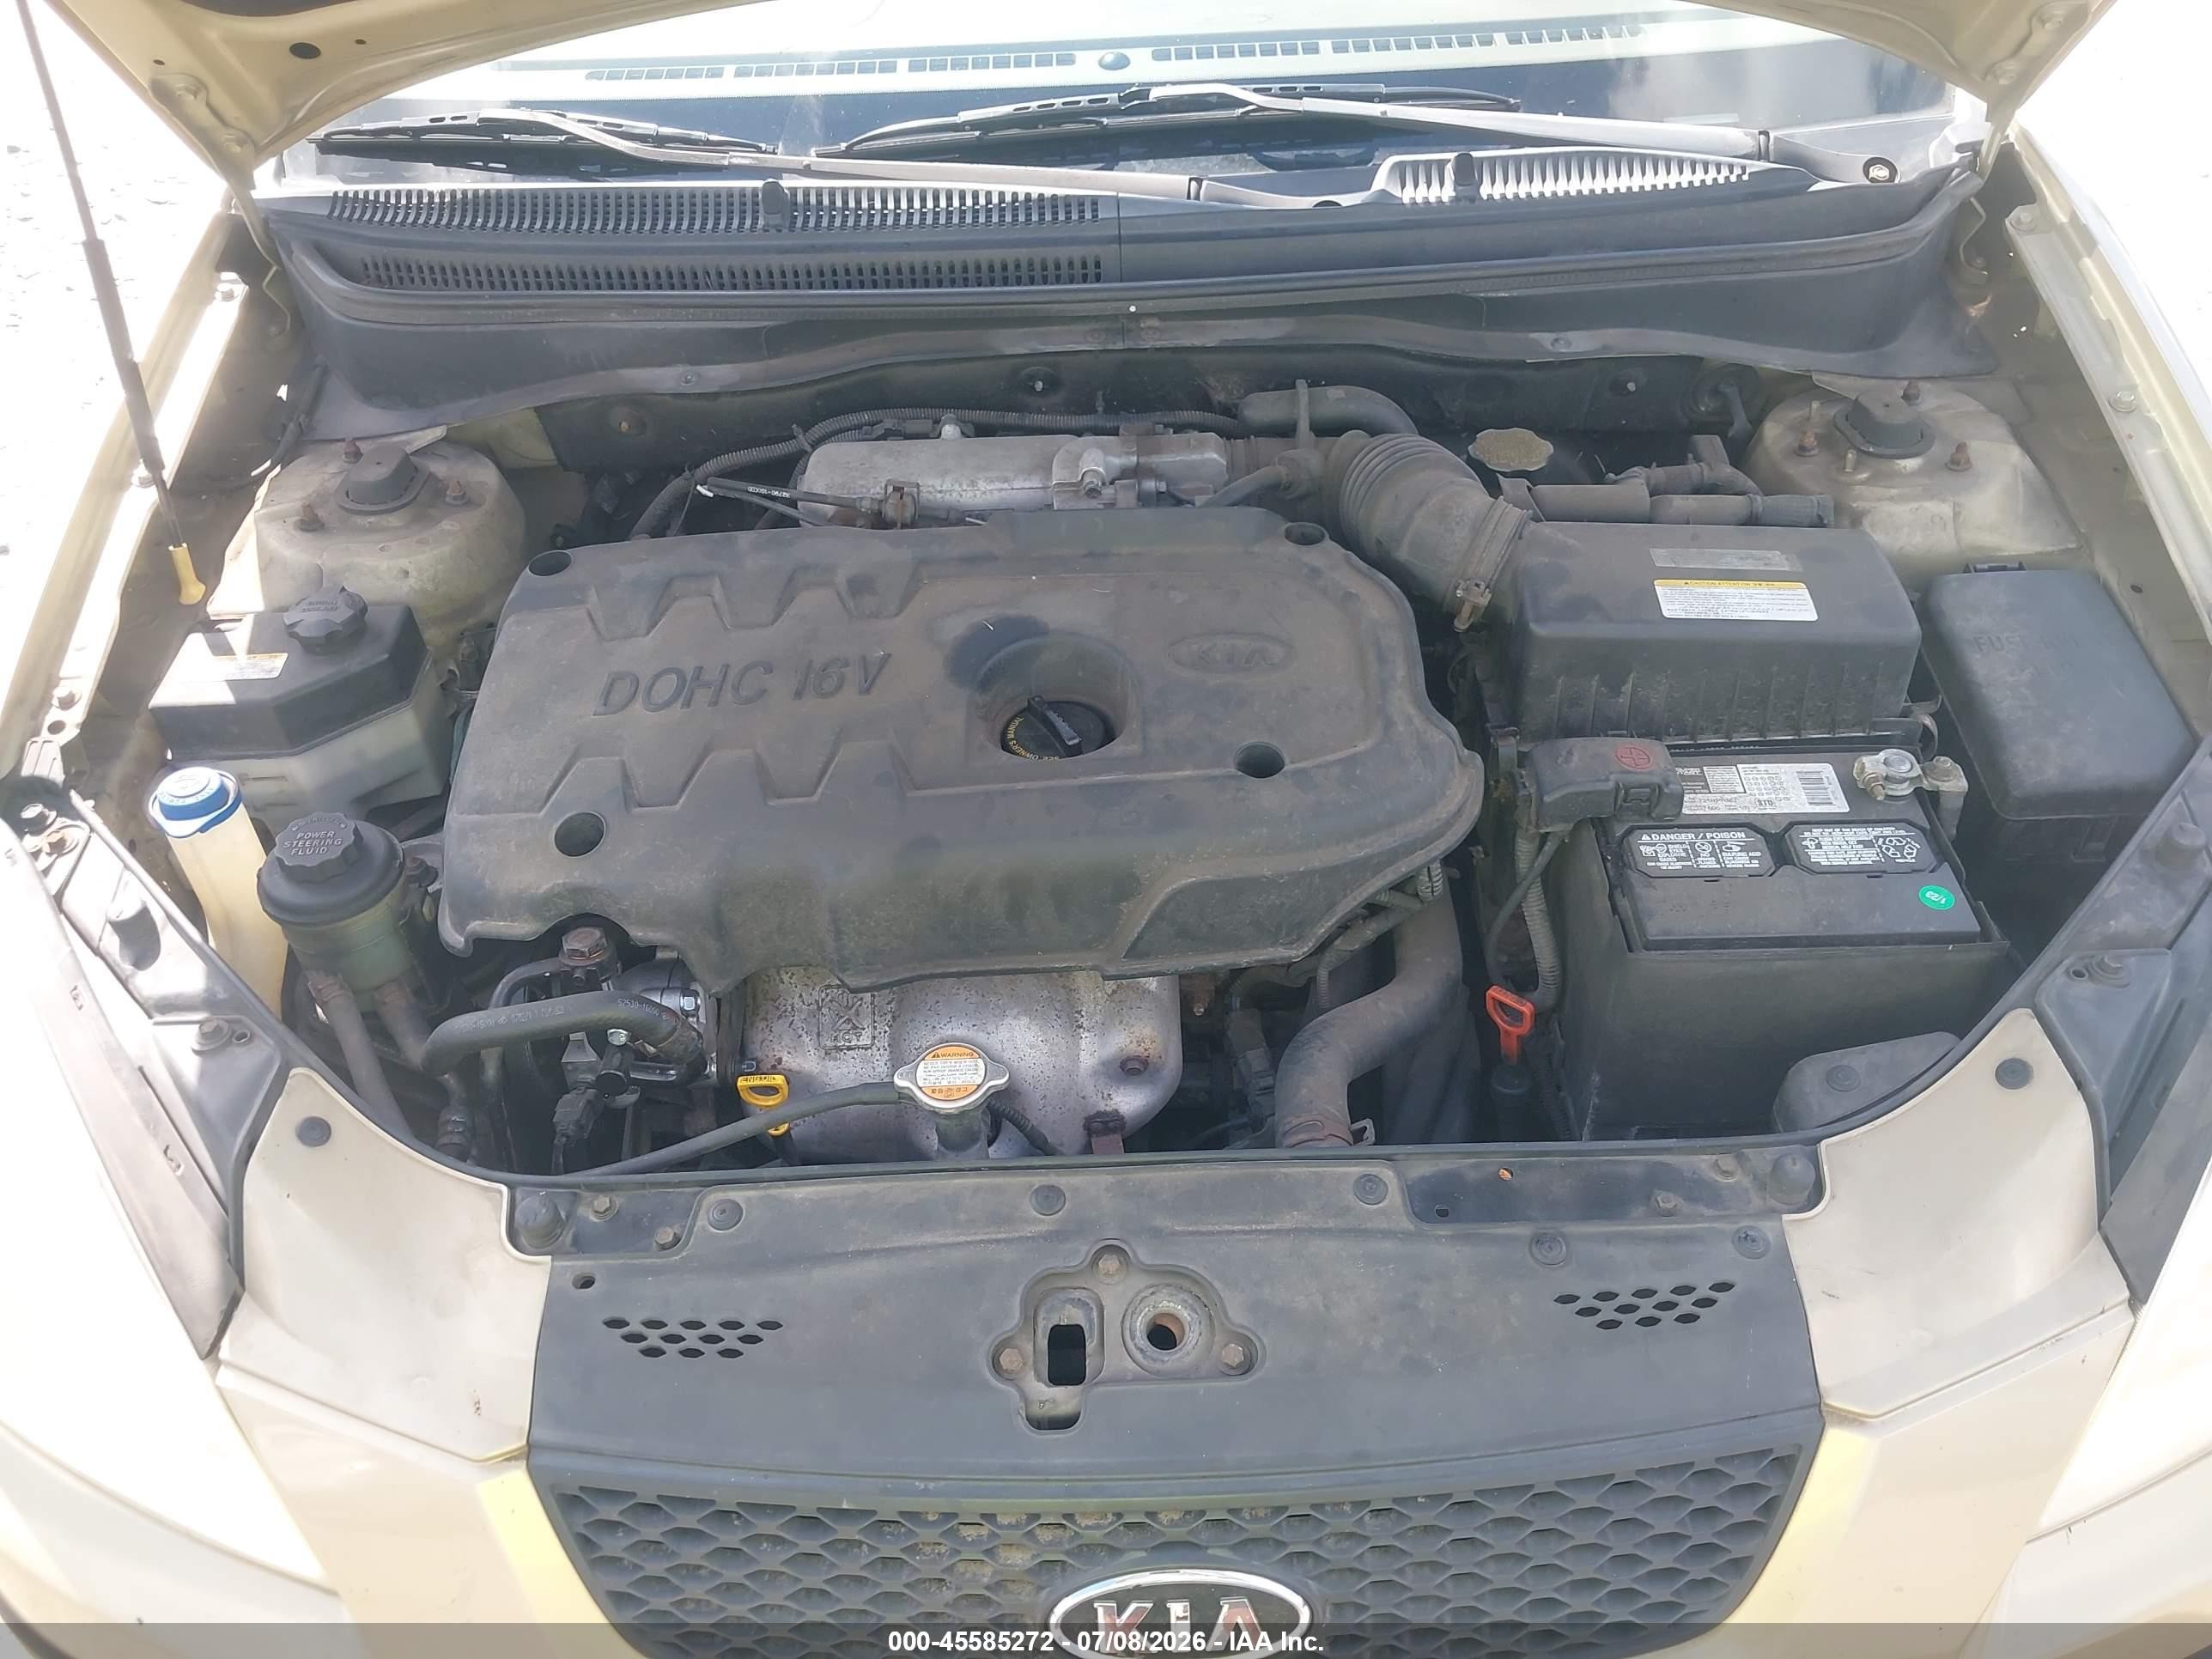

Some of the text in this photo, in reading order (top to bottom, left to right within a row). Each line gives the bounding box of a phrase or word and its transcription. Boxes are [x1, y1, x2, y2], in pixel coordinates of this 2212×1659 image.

[592, 652, 893, 717] DOHC 16V
[296, 830, 336, 840] POWER
[1705, 831, 1746, 840] POISON
[283, 838, 343, 848] STEERING
[290, 847, 328, 856] FLUID
[1092, 1596, 1271, 1655] KIA
